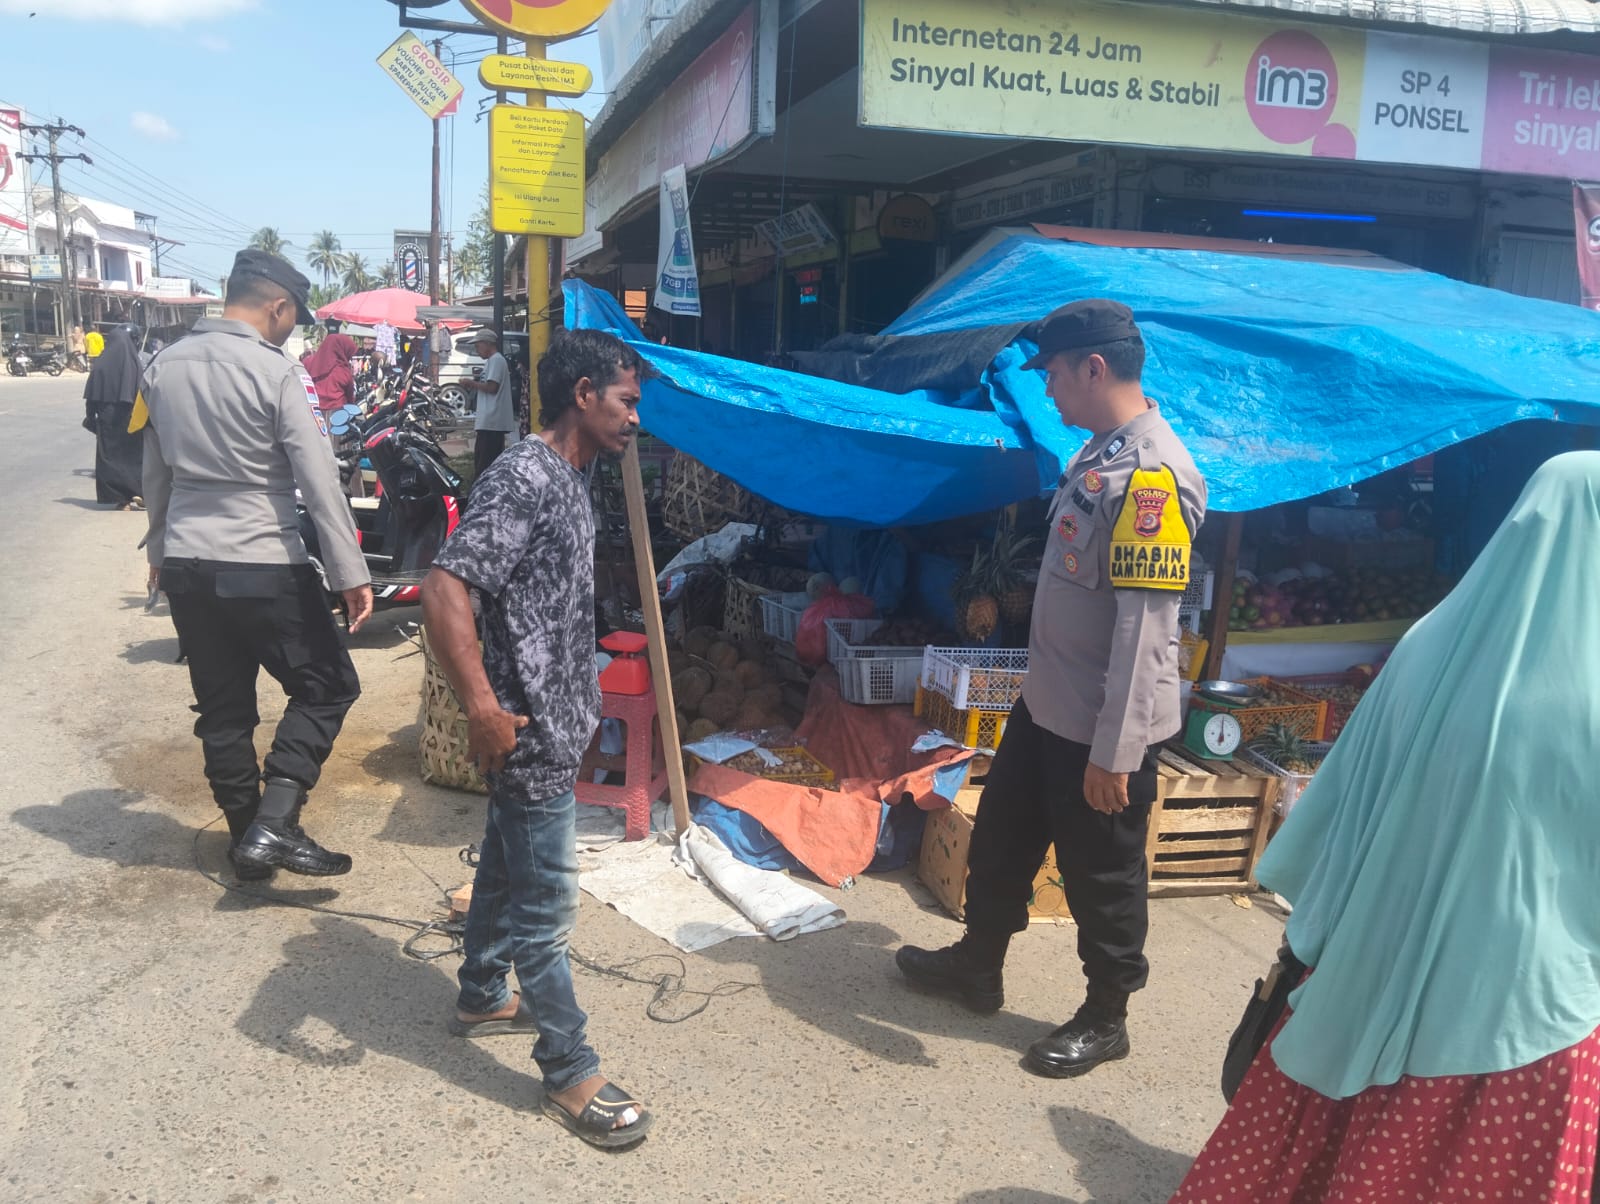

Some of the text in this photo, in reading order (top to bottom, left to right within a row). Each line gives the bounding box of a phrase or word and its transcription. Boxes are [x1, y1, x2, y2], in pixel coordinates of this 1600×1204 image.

[892, 17, 1142, 63] Internetan 24 Jam
[396, 45, 425, 75] VOUCHER
[427, 79, 449, 101] TOKEN
[411, 44, 450, 85] GROSIR
[499, 60, 521, 69] Pusat
[560, 67, 575, 75] dan
[394, 57, 415, 78] KARTU
[417, 81, 437, 101] PULSA
[501, 71, 534, 81] Layanan
[890, 57, 1220, 107] Sinyal Kuat, Luas & Stabil
[1400, 69, 1451, 97] SP 4
[388, 64, 430, 106] SPAREPART HP
[1519, 70, 1556, 107] Tri
[541, 117, 569, 126] Perdana
[1374, 102, 1470, 134] PONSEL
[528, 124, 546, 132] Paket
[548, 125, 563, 133] Data
[511, 138, 542, 147] Informasi
[532, 149, 559, 157] Layanan
[499, 165, 540, 175] Pendaftaran
[523, 194, 542, 202] Ulang
[519, 217, 537, 225] Ganti
[1114, 546, 1182, 563] BHABIN
[1112, 562, 1186, 580] KAMTIBMAS
